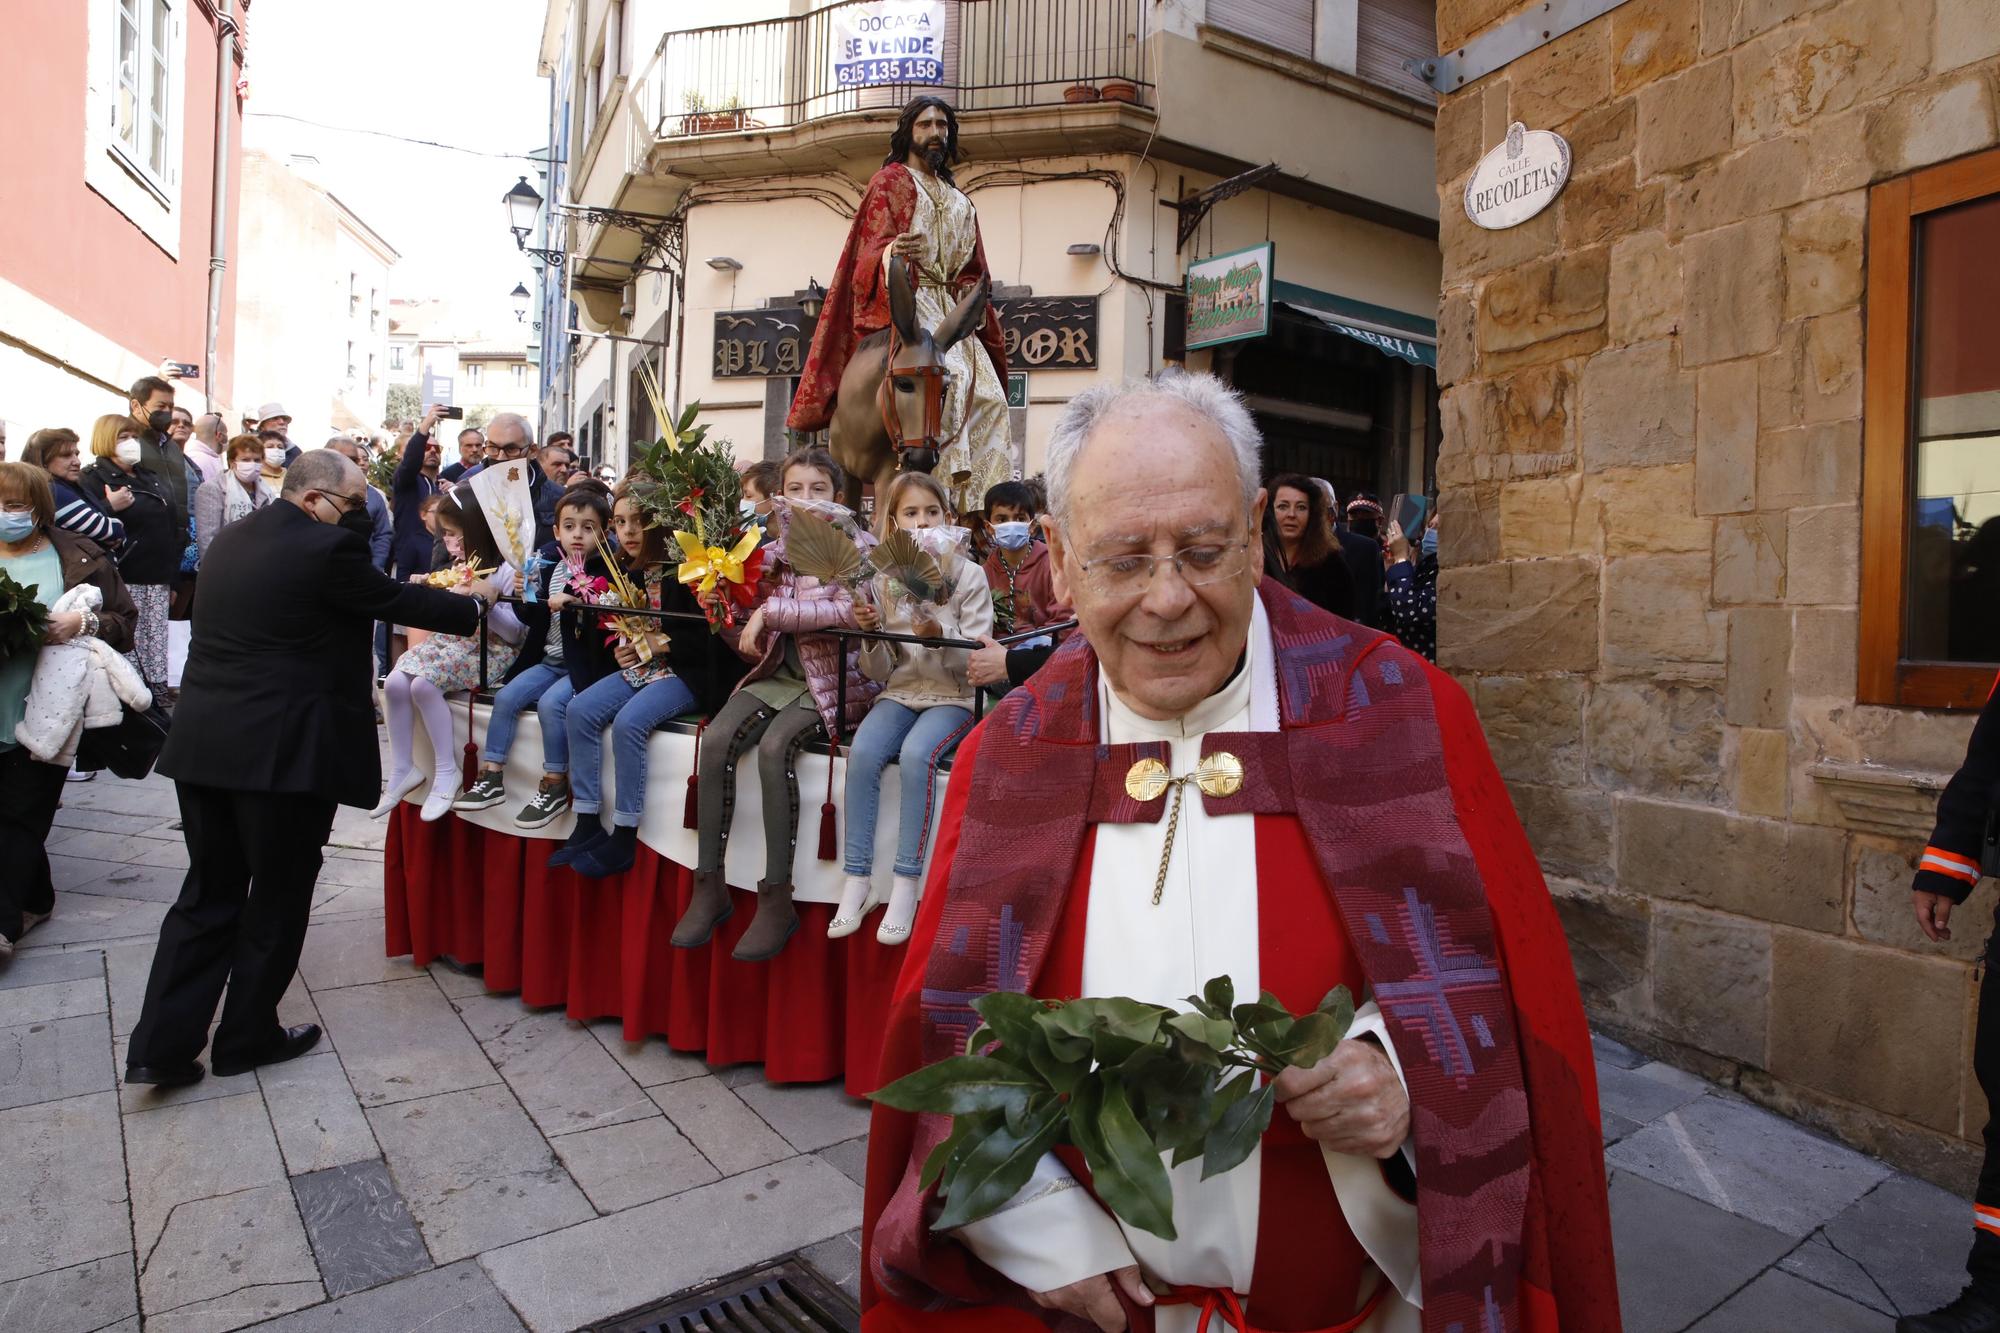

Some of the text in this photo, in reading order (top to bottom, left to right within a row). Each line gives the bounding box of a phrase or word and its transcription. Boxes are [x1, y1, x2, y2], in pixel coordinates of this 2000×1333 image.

[860, 12, 931, 32] DOCASA
[845, 37, 934, 60] SE VENDE
[840, 60, 937, 83] 615 135 158
[1498, 157, 1532, 178] CALLE
[1475, 162, 1558, 214] RECOLETAS
